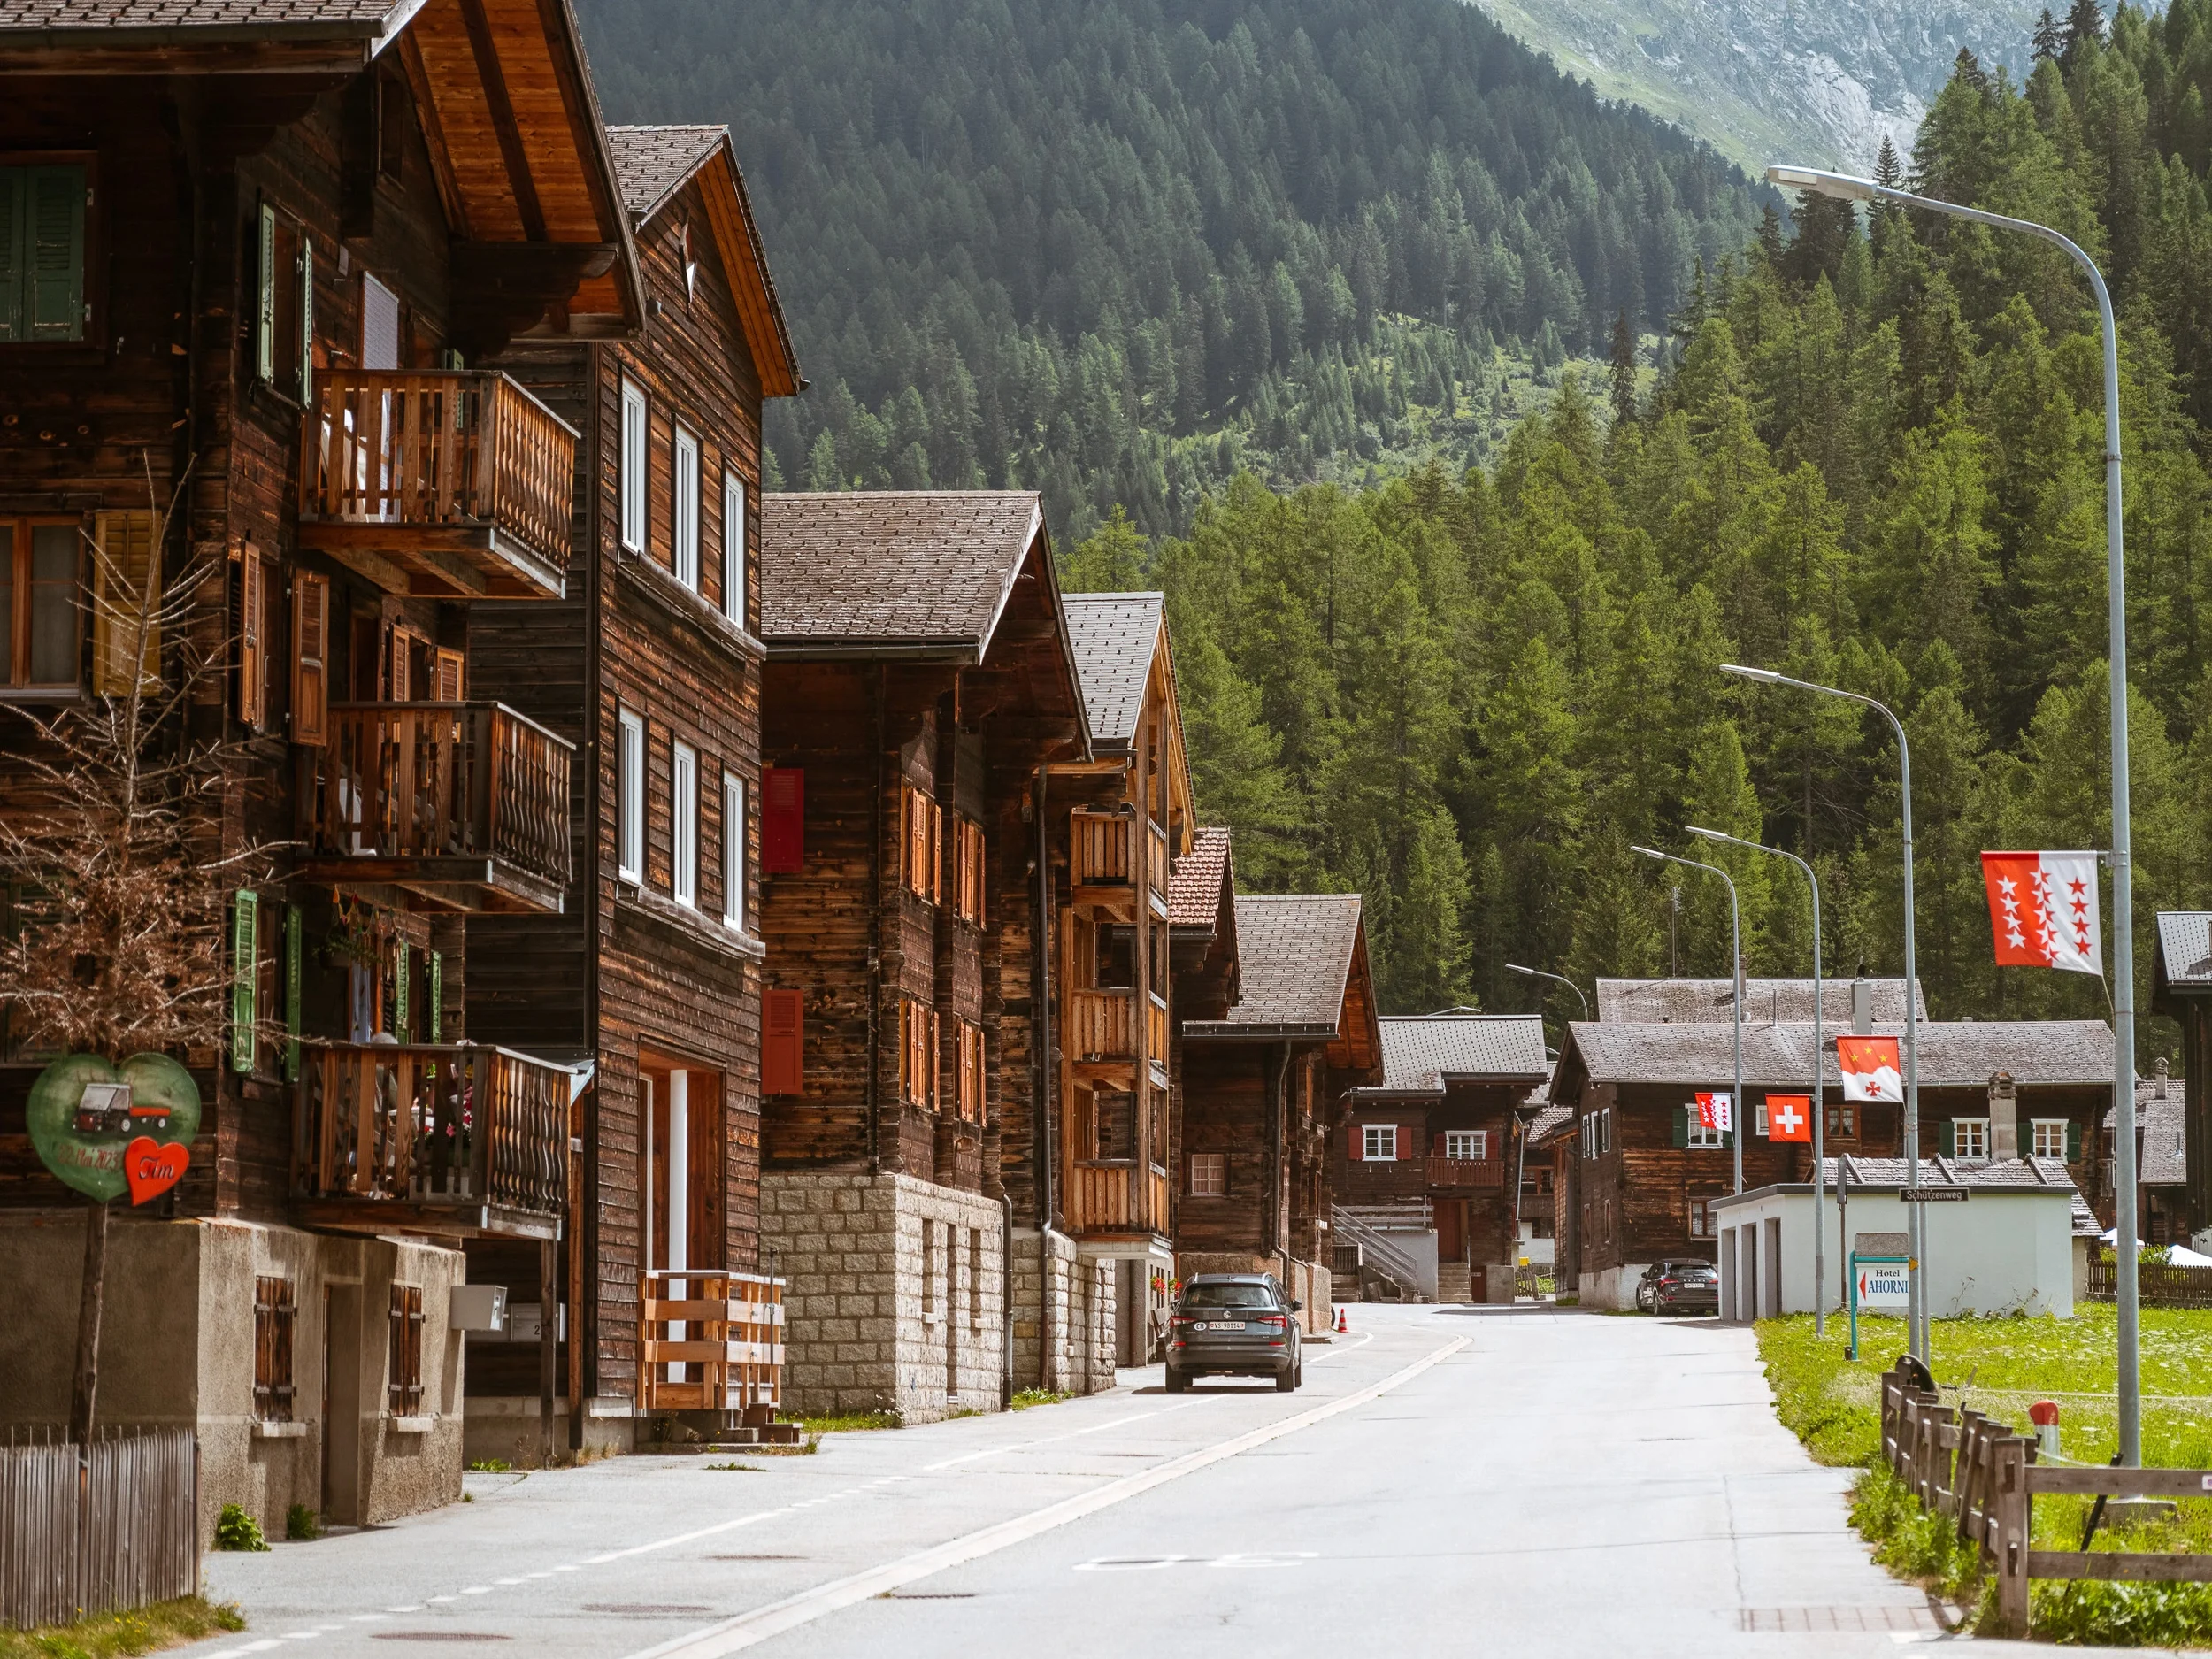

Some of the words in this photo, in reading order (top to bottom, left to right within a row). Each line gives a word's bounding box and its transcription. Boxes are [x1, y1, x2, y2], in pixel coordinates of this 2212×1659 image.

[139, 1156, 175, 1179] Tim
[1907, 1190, 1962, 1201] Schützenweg
[1868, 1279, 1909, 1294] AHORNI
